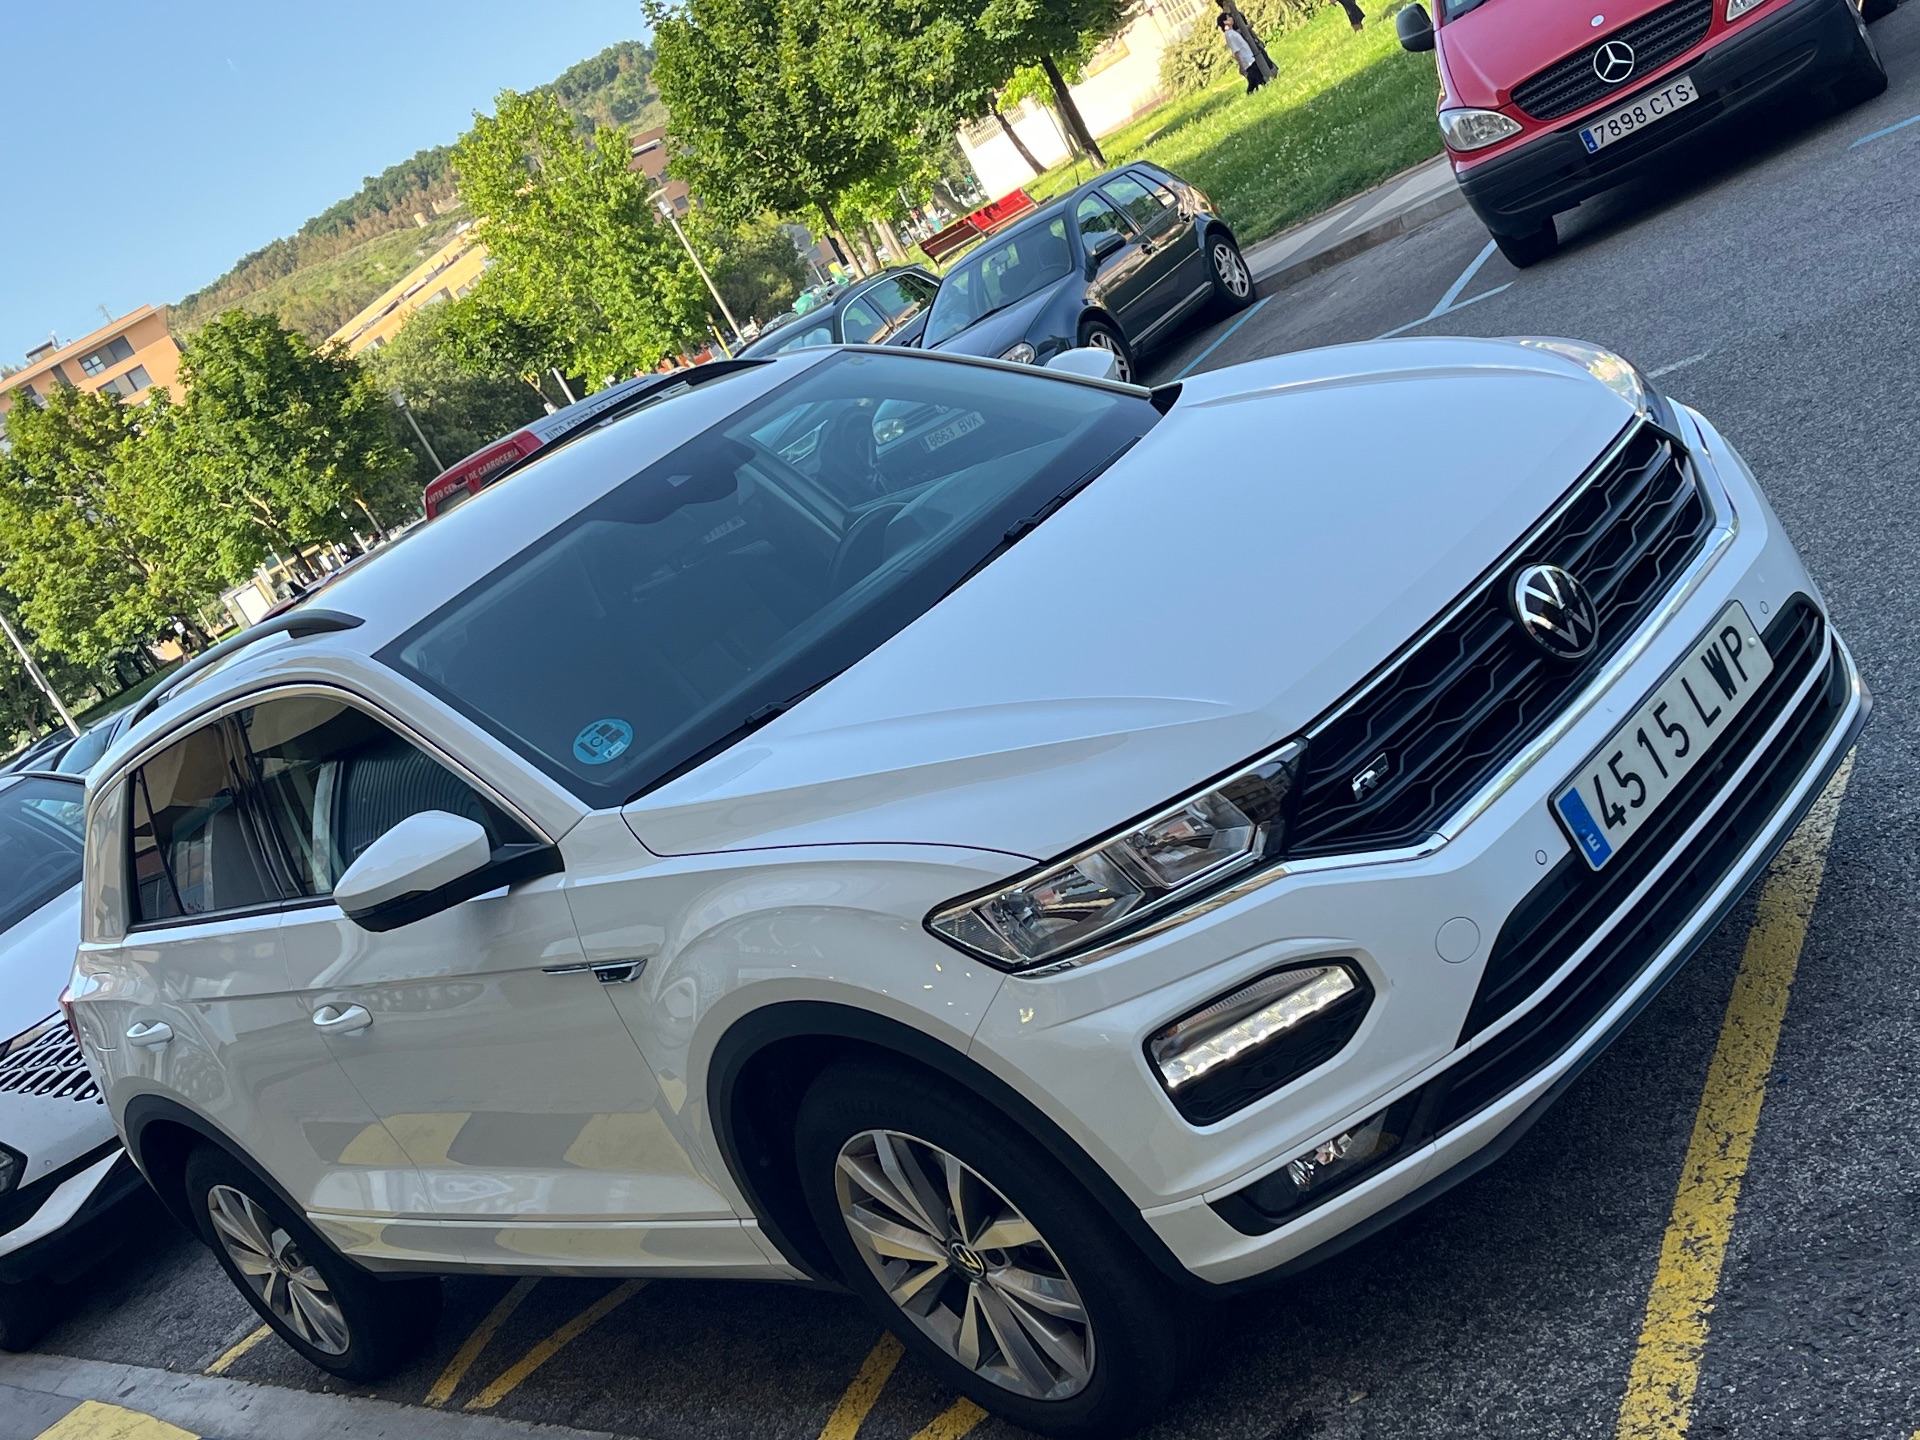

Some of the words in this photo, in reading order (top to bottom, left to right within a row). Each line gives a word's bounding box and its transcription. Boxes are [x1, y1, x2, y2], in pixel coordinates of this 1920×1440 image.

[1594, 106, 1647, 145] 7898
[1649, 84, 1690, 116] CTS
[928, 427, 955, 447] 8663
[957, 413, 981, 433] BVK
[427, 490, 444, 505] AUTO
[478, 447, 520, 476] CARROCERIA
[1591, 702, 1691, 831] 4515
[1681, 625, 1749, 728] LWP
[1586, 832, 1601, 852] E
